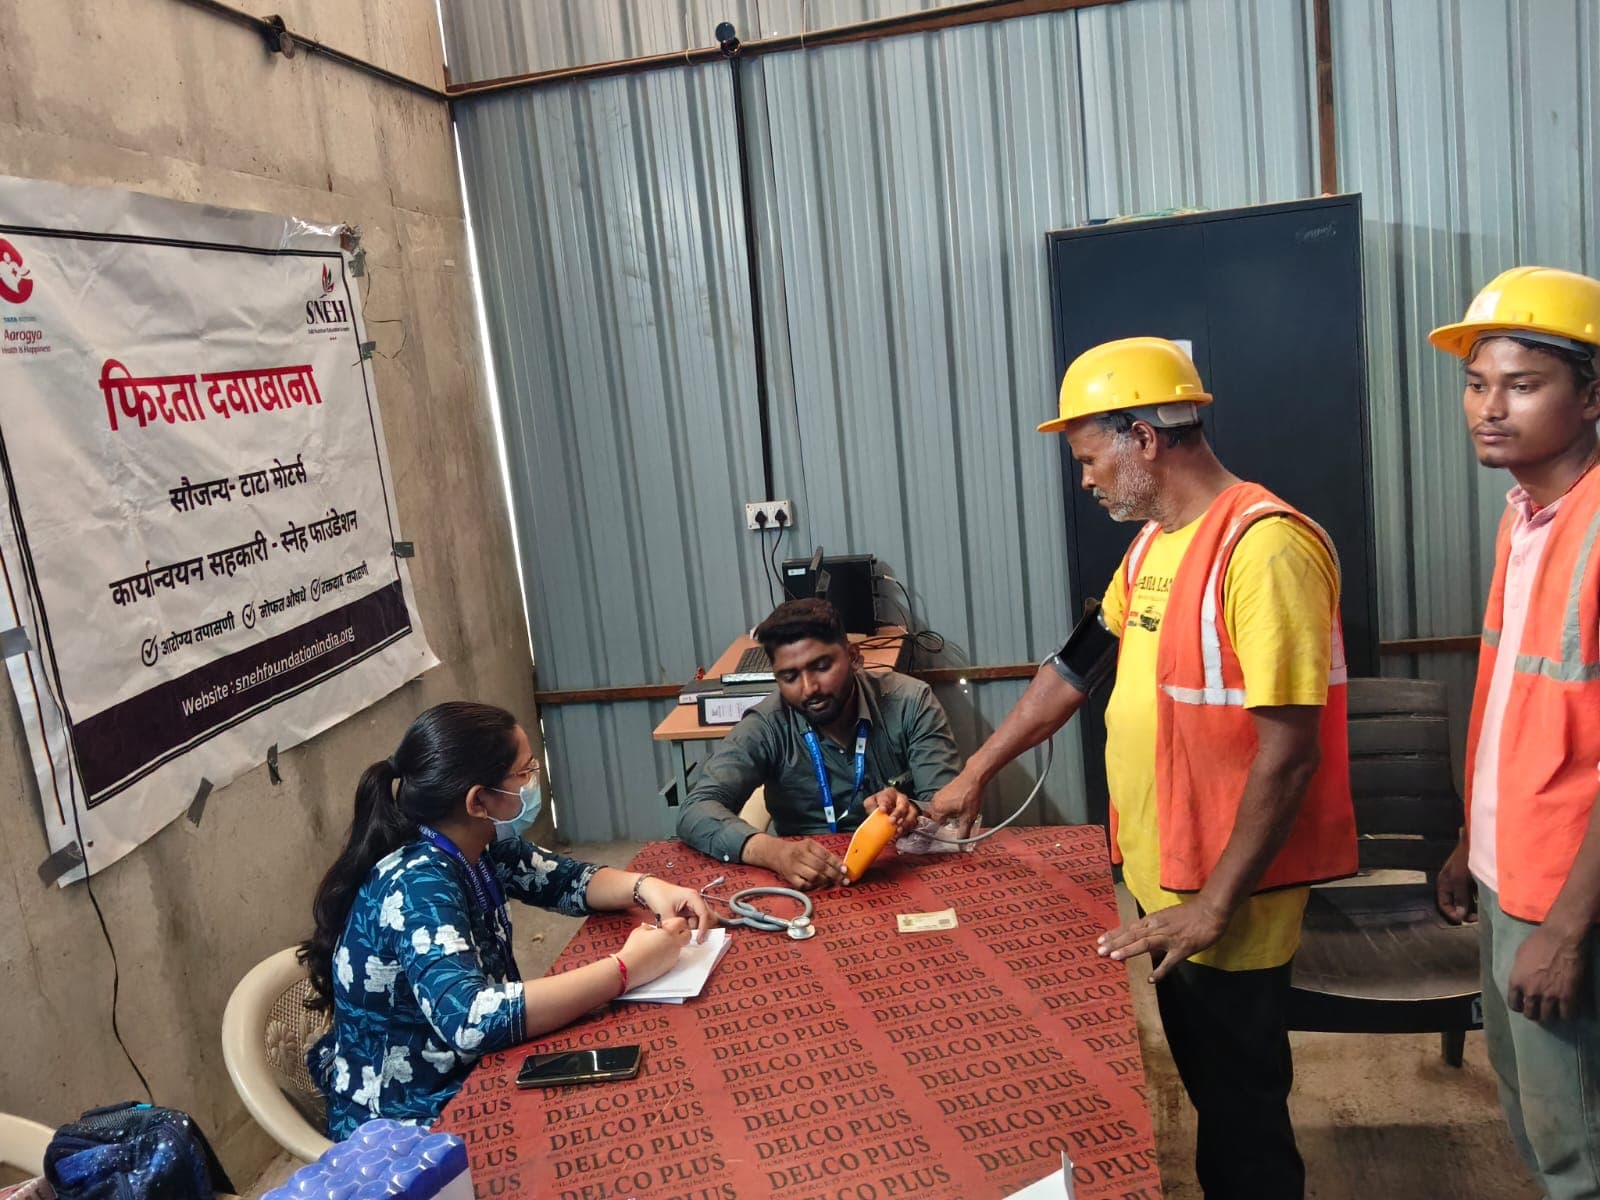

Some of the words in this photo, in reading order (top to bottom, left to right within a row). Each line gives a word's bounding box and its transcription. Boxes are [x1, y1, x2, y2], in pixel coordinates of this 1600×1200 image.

[306, 300, 348, 324] SNEH
[4, 329, 42, 344] Aarogya
[99, 359, 206, 431] फिरता
[201, 365, 322, 419] दवाखाना
[239, 470, 270, 498] टाटा
[270, 454, 307, 489] मोटर्स
[109, 560, 204, 606] कार्यान्वयन
[207, 530, 269, 578] सहकारी
[280, 521, 309, 553] स्नेह
[308, 508, 359, 544] फाउंडेशन
[161, 630, 193, 656] आरोग्य
[195, 611, 236, 643] तपासणी
[182, 684, 230, 717] Website
[235, 625, 356, 693] snehfoundationindia.org
[1022, 830, 1079, 847] DELCO
[1038, 841, 1095, 859] DELCO
[917, 863, 977, 883] DELCO
[978, 855, 1021, 871] PLUS
[930, 876, 991, 896] DELCO
[992, 867, 1037, 883] PLUS
[856, 880, 900, 895] PLUS
[868, 891, 912, 908] PLUS
[944, 890, 1006, 909] DELCO
[1006, 880, 1053, 896] PLUS
[959, 903, 1022, 924] DELCO
[1023, 893, 1071, 911] PLUS
[973, 916, 1039, 939] DELCO
[1041, 907, 1089, 924] PLUS
[587, 918, 633, 936] PLUS
[815, 916, 876, 938] DELCO
[823, 930, 889, 952] DELCO
[988, 932, 1057, 955] DELCO
[1057, 921, 1107, 941] PLUS
[752, 948, 802, 968] PLUS
[834, 945, 902, 969] DELCO
[903, 934, 954, 953] PLUS
[846, 961, 916, 986] DELCO
[917, 950, 970, 969] PLUS
[1005, 949, 1076, 972] DELCO
[762, 963, 813, 984] PLUS
[858, 979, 931, 1003] DELCO
[932, 967, 987, 987] PLUS
[1023, 966, 1097, 991] DELCO
[695, 994, 768, 1020] DELCO
[771, 981, 824, 1002] PLUS
[872, 997, 947, 1023] DELCO
[948, 984, 1004, 1006] PLUS
[1042, 984, 1117, 1010] DELCO
[616, 1016, 671, 1038] PLUS
[702, 1012, 779, 1041] DELCO
[781, 999, 837, 1021] PLUS
[885, 1016, 964, 1044] DELCO
[965, 1004, 1023, 1026] PLUS
[711, 1032, 790, 1061] DELCO
[793, 1018, 850, 1041] PLUS
[902, 1037, 982, 1066] DELCO
[982, 1024, 1042, 1048] PLUS
[643, 1055, 687, 1077] LUS
[722, 1053, 802, 1083] DELCO
[805, 1038, 864, 1063] PLUS
[918, 1060, 1002, 1090] DELCO
[1003, 1046, 1064, 1071] PLUS
[466, 1074, 509, 1097] LUS
[732, 1075, 815, 1107] DELCO
[818, 1060, 878, 1086] PLUS
[937, 1083, 1022, 1115] DELCO
[1024, 1069, 1087, 1095] PLUS
[452, 1096, 512, 1123] PLUS
[545, 1093, 630, 1126] DELCO
[636, 1077, 695, 1103] PLUS
[742, 1100, 828, 1132] DELCO
[833, 1084, 895, 1110] PLUS
[955, 1109, 1045, 1142] DELCO
[1045, 1094, 1111, 1121] PLUS
[549, 1116, 636, 1151] DELCO
[641, 1100, 704, 1128] PLUS
[754, 1125, 844, 1160] DELCO
[846, 1108, 912, 1137] PLUS
[470, 1145, 518, 1171] LUS
[555, 1142, 645, 1180] DELCO
[649, 1125, 714, 1154] PLUS
[976, 1136, 1069, 1172] DELCO
[1066, 1119, 1138, 1148] PLUS
[659, 1152, 726, 1184] PLUS
[767, 1153, 860, 1191] DELCO
[863, 1135, 932, 1165] PLUS
[880, 1163, 951, 1197] PLUS
[472, 1172, 522, 1200] LUS
